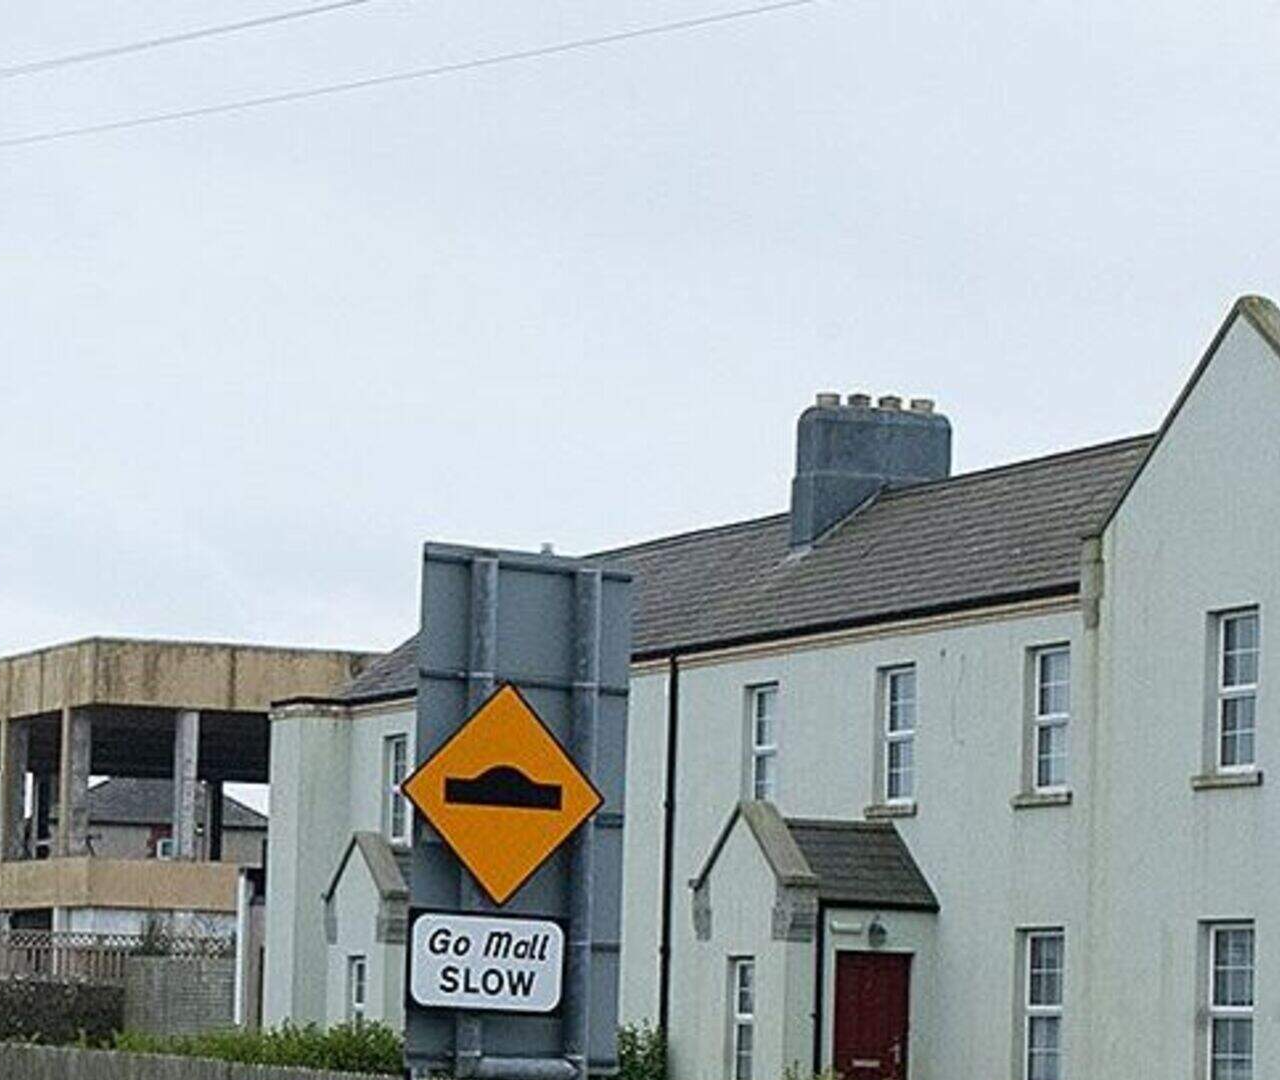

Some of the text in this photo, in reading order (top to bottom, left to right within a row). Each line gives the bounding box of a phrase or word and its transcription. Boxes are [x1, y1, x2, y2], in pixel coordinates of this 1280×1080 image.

[429, 928, 549, 961] Go Mall
[439, 965, 535, 996] SLOW
